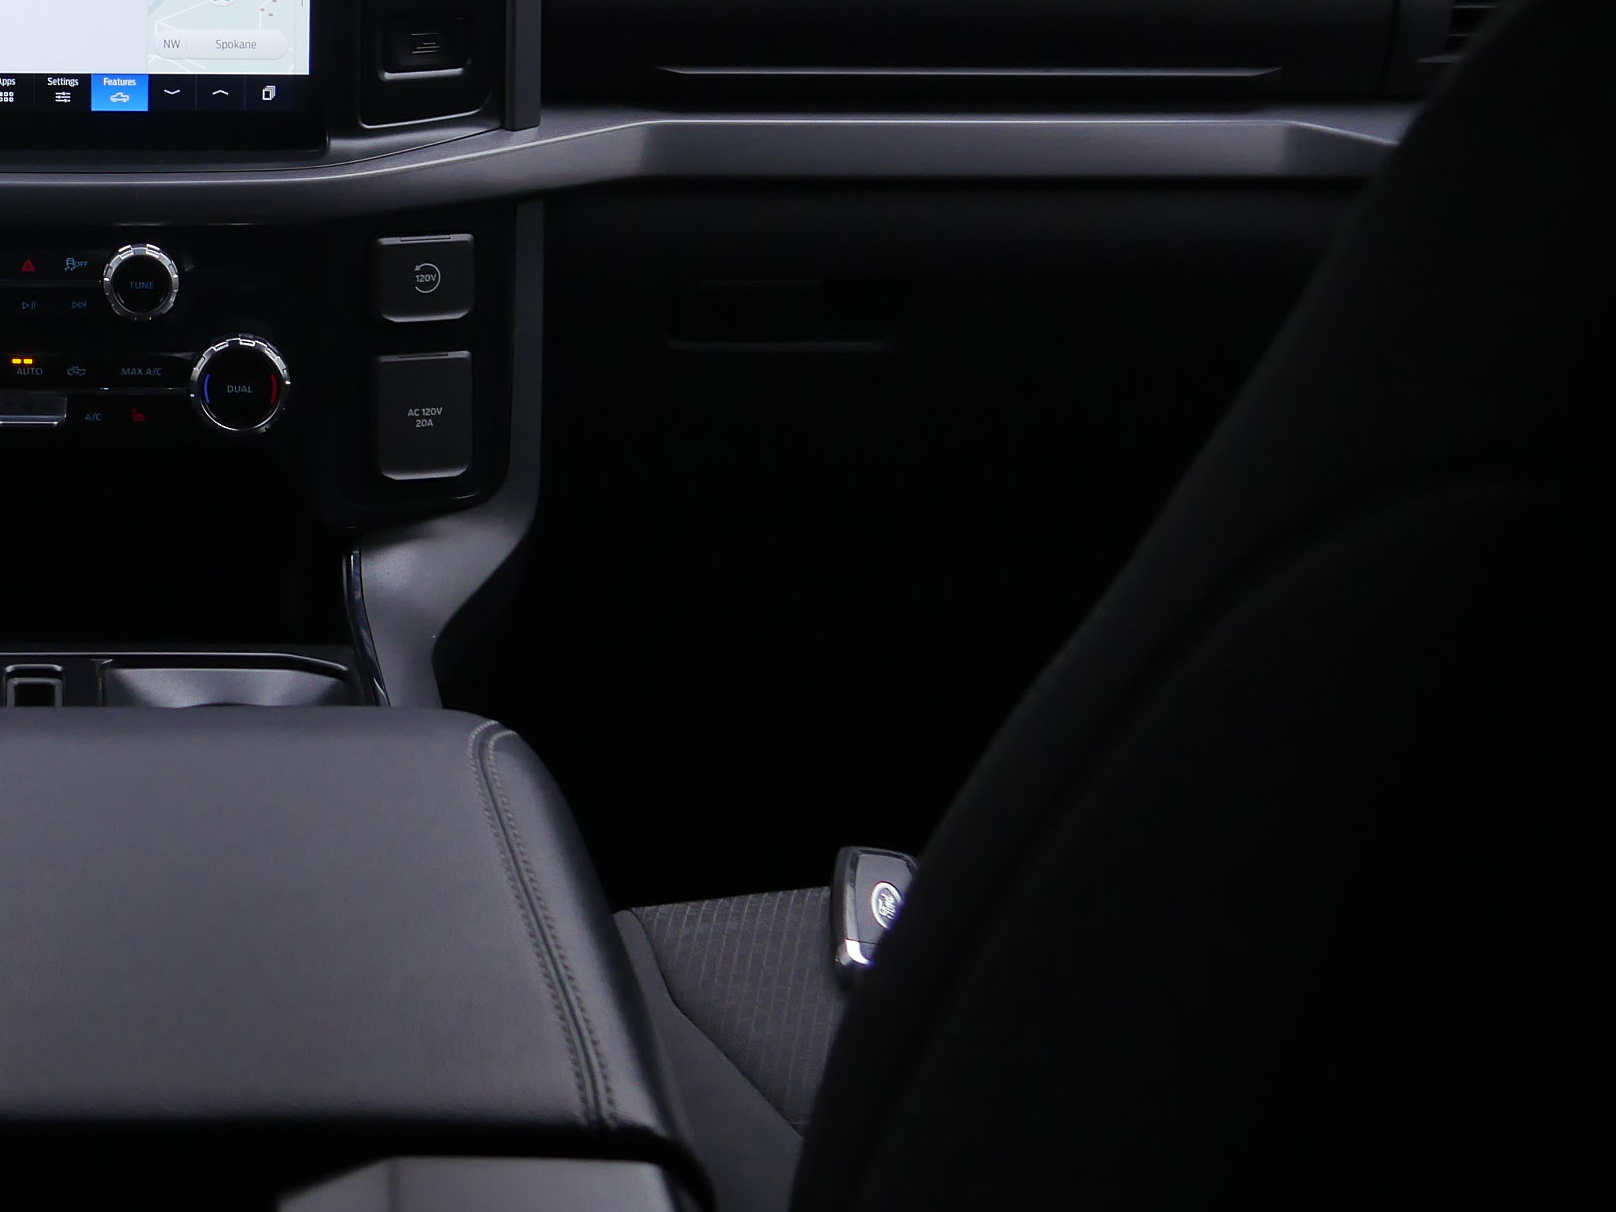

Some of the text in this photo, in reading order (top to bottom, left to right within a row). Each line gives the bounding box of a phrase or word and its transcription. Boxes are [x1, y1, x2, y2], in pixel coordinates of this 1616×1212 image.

[163, 39, 181, 49] NW
[215, 39, 257, 51] Spokane
[47, 77, 79, 87] Settings
[103, 77, 136, 86] Features
[415, 274, 437, 282] 120V
[127, 280, 156, 290] TUNE
[15, 367, 43, 377] AUTO
[120, 366, 163, 377] MAX A/C
[226, 384, 253, 394] DUAL
[83, 412, 102, 422] A/C
[407, 407, 443, 418] AC 120V
[415, 419, 434, 428] 20A
